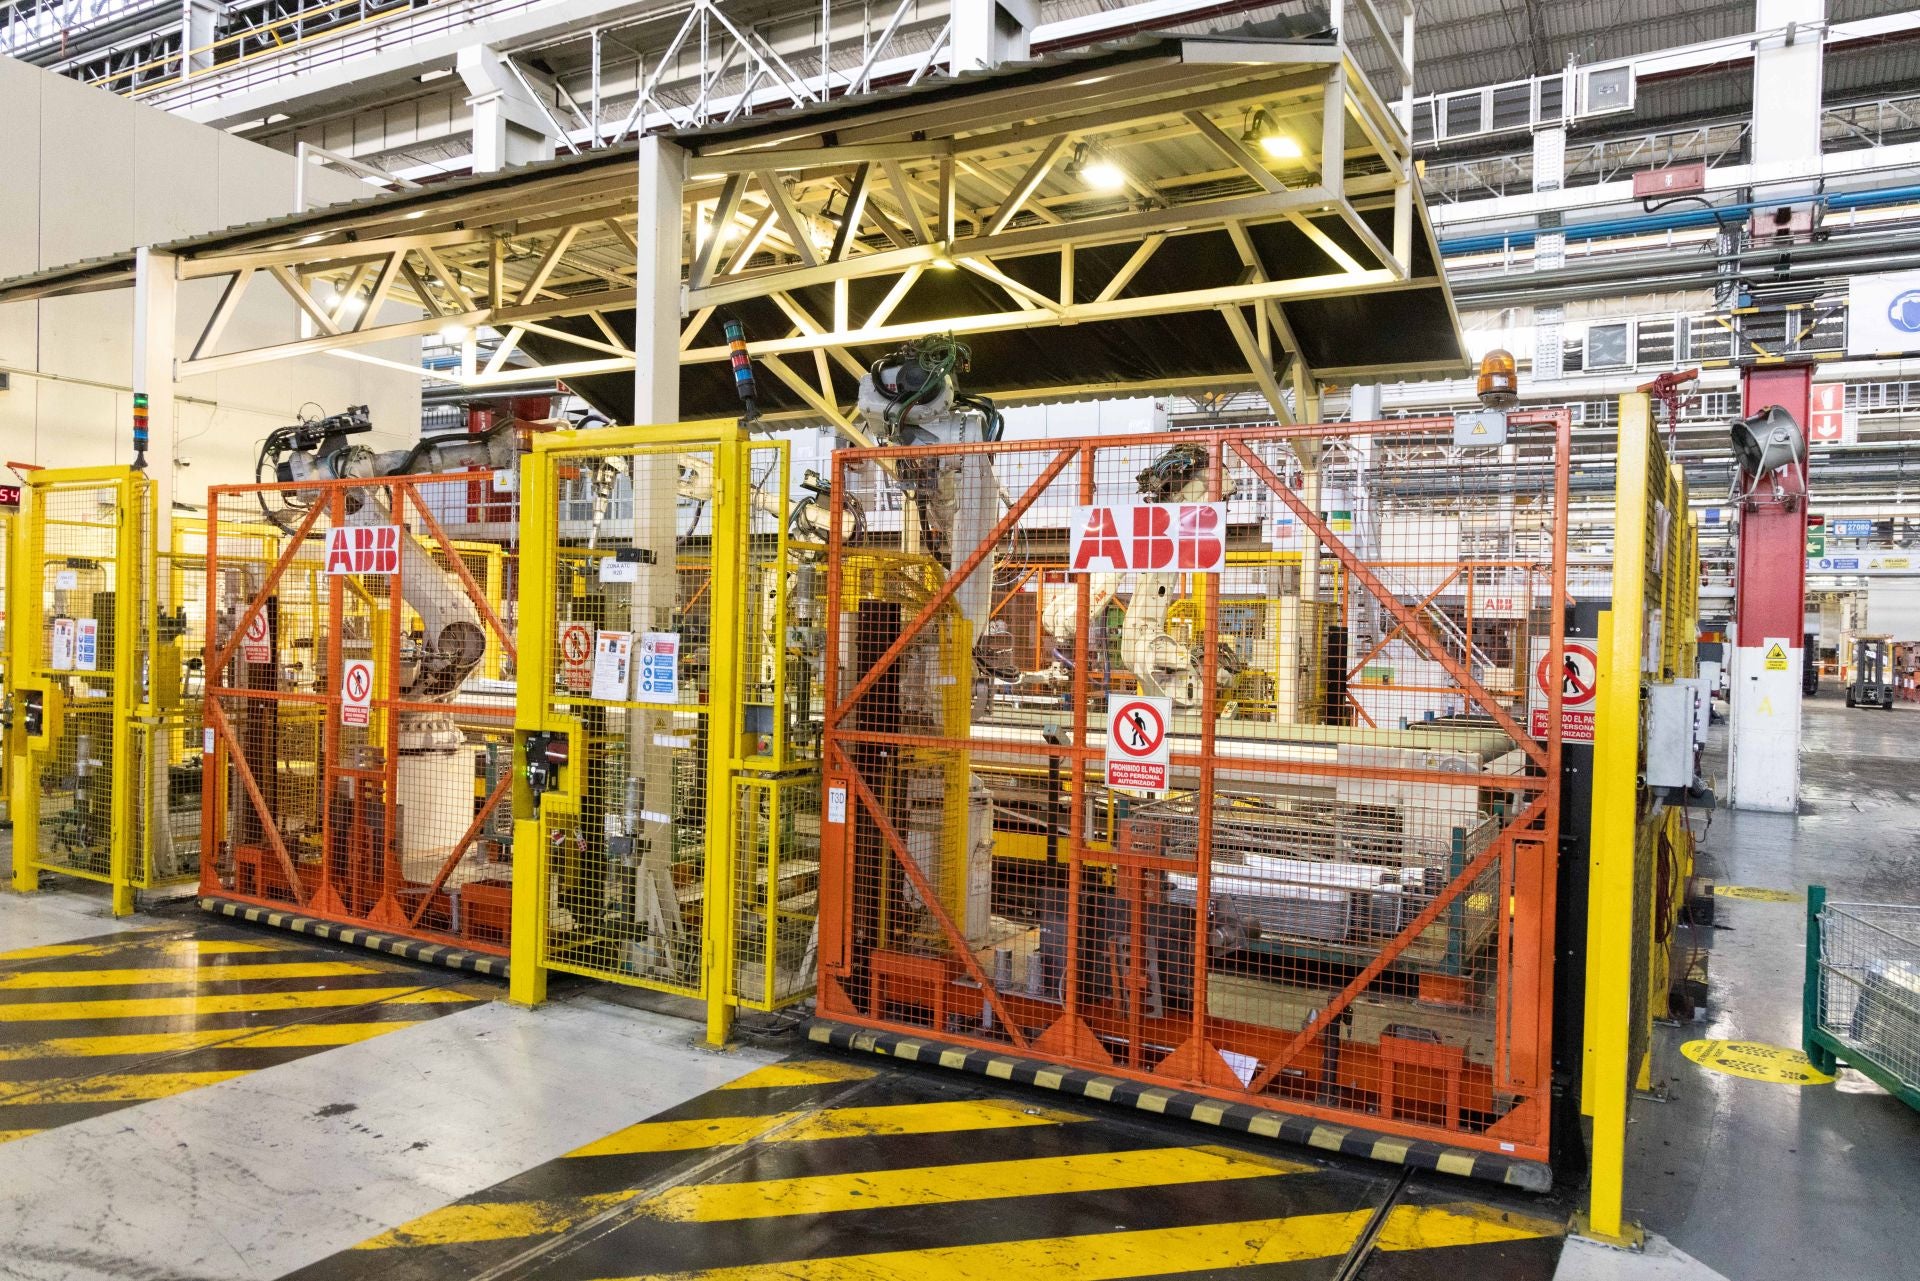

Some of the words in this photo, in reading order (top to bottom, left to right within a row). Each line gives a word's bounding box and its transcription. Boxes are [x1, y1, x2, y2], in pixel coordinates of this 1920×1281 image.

[1073, 505, 1222, 569] ABB
[327, 528, 397, 571] ABB
[1485, 599, 1512, 609] ABB
[1574, 715, 1582, 723] EL
[1111, 763, 1140, 772] PROHIBIDO
